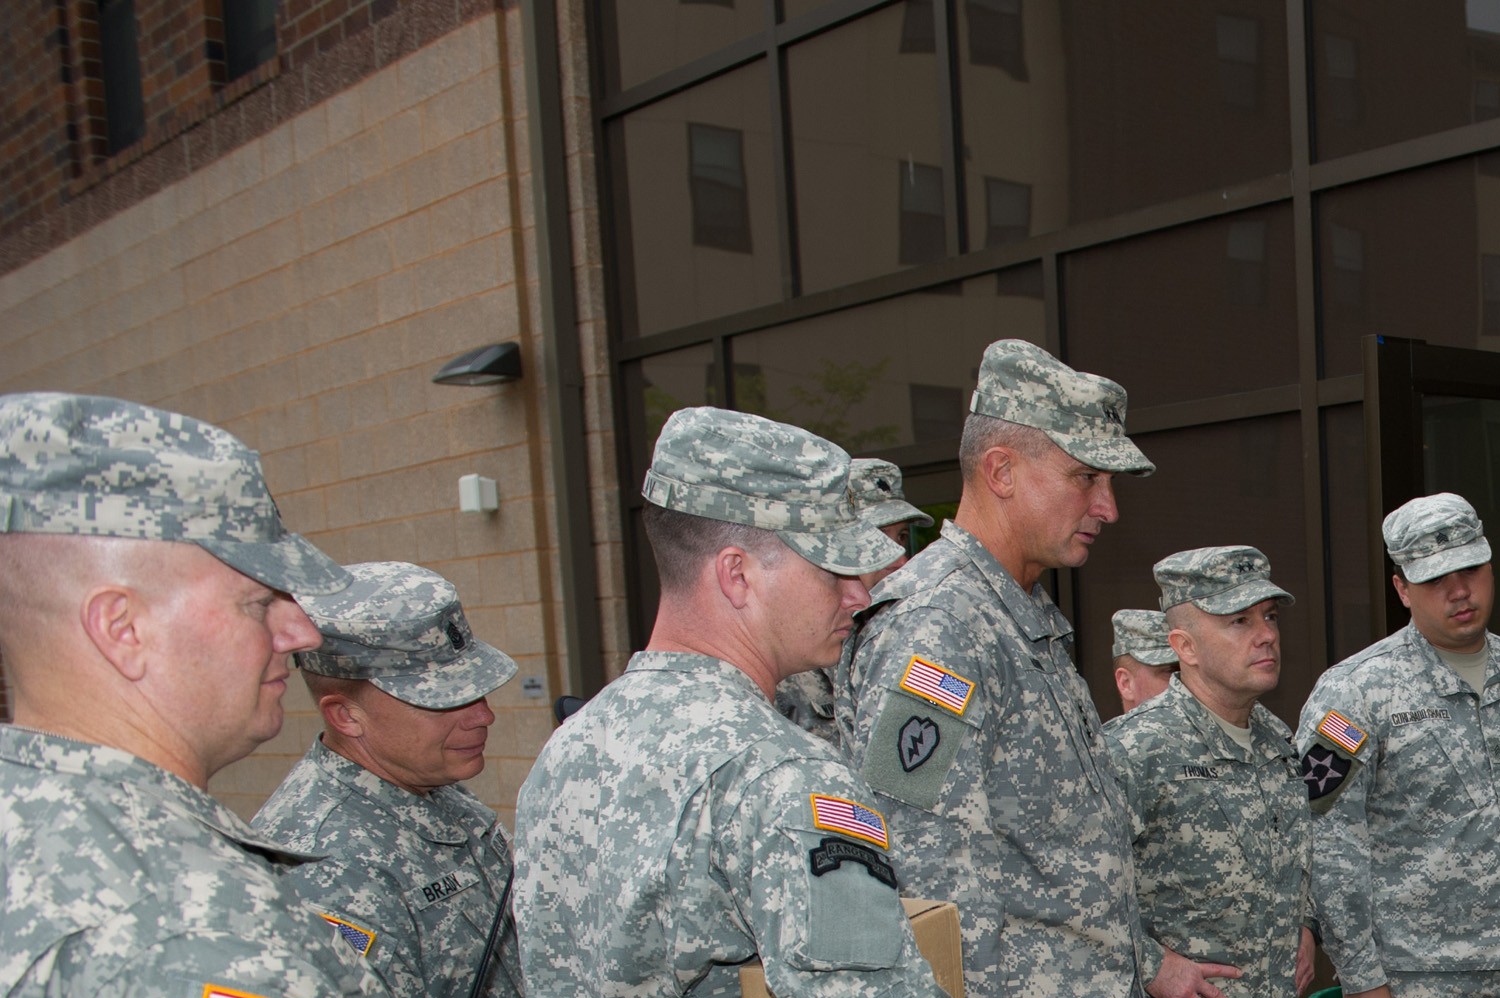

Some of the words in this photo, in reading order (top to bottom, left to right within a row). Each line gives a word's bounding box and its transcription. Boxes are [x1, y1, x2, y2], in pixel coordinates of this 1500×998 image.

[1182, 764, 1219, 779] THOMAS
[827, 843, 876, 864] RANGER
[422, 873, 462, 902] BRADY
